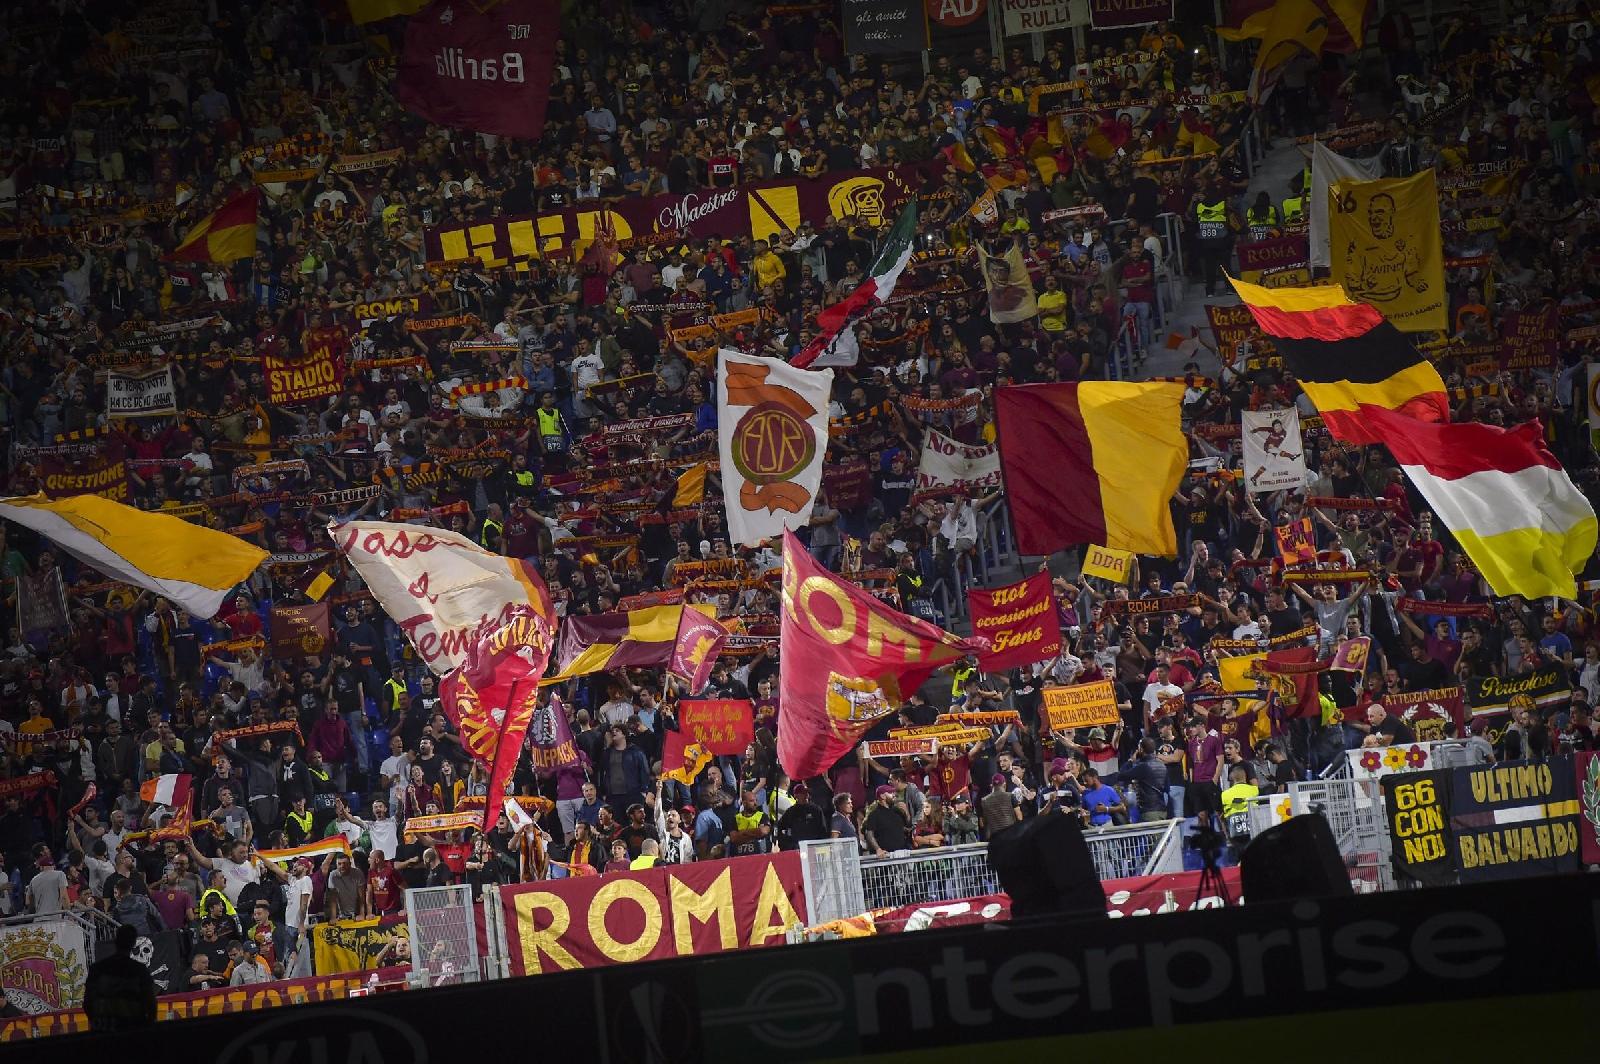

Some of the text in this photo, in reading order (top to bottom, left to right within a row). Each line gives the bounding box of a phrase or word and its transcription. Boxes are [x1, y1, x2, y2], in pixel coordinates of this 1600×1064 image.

[1021, 8, 1071, 29] RULLI
[659, 188, 738, 230] Maestro
[1247, 246, 1297, 263] ROMA
[270, 359, 336, 392] STADIO
[271, 391, 288, 404] MI
[926, 432, 955, 456] No
[47, 463, 125, 490] QUESTIONE
[991, 582, 1028, 607] Not
[976, 596, 1050, 628] occasional
[992, 625, 1043, 653] Fans
[1211, 625, 1317, 648] VECCHIE MANIERE
[1385, 686, 1460, 707] ATTEGGIAMENTO
[1479, 671, 1558, 698] Pericolose
[1393, 780, 1436, 811] 66
[1470, 764, 1553, 804] ULTIMO
[1394, 805, 1445, 838] CON
[1402, 834, 1446, 865] NOI
[1458, 821, 1578, 869] BALUARDO
[513, 862, 801, 976] ROMA
[740, 900, 1508, 1052] enterprise
